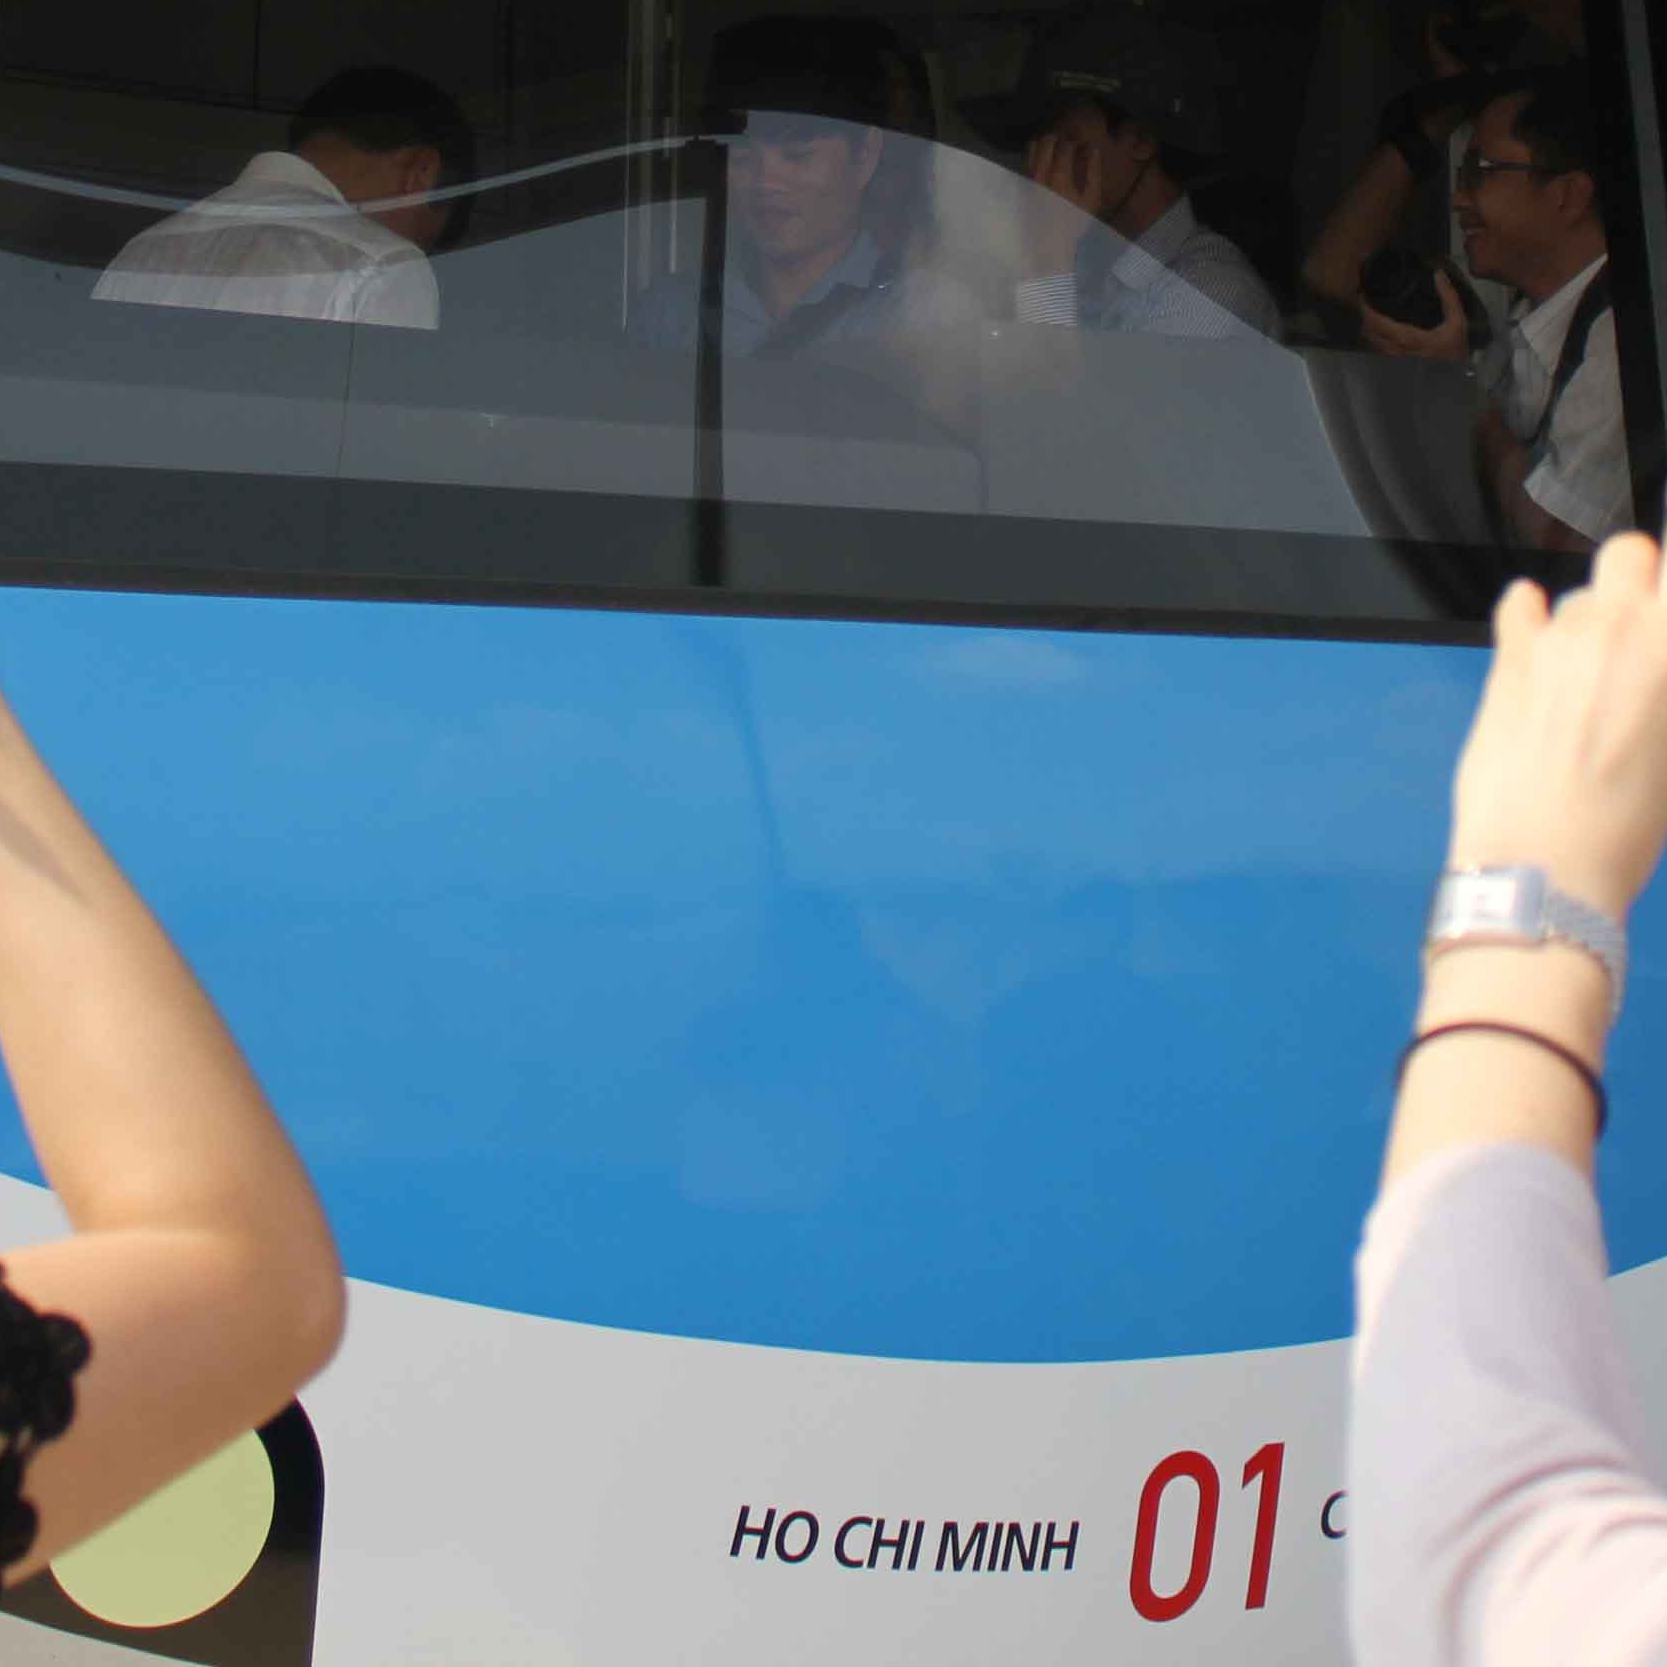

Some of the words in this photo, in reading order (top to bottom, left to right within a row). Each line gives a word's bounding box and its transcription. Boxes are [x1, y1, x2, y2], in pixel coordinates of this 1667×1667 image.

[730, 1505, 820, 1564] HO
[833, 1515, 925, 1571] CHI
[934, 1520, 1080, 1572] MINH
[1129, 1441, 1286, 1623] 01
